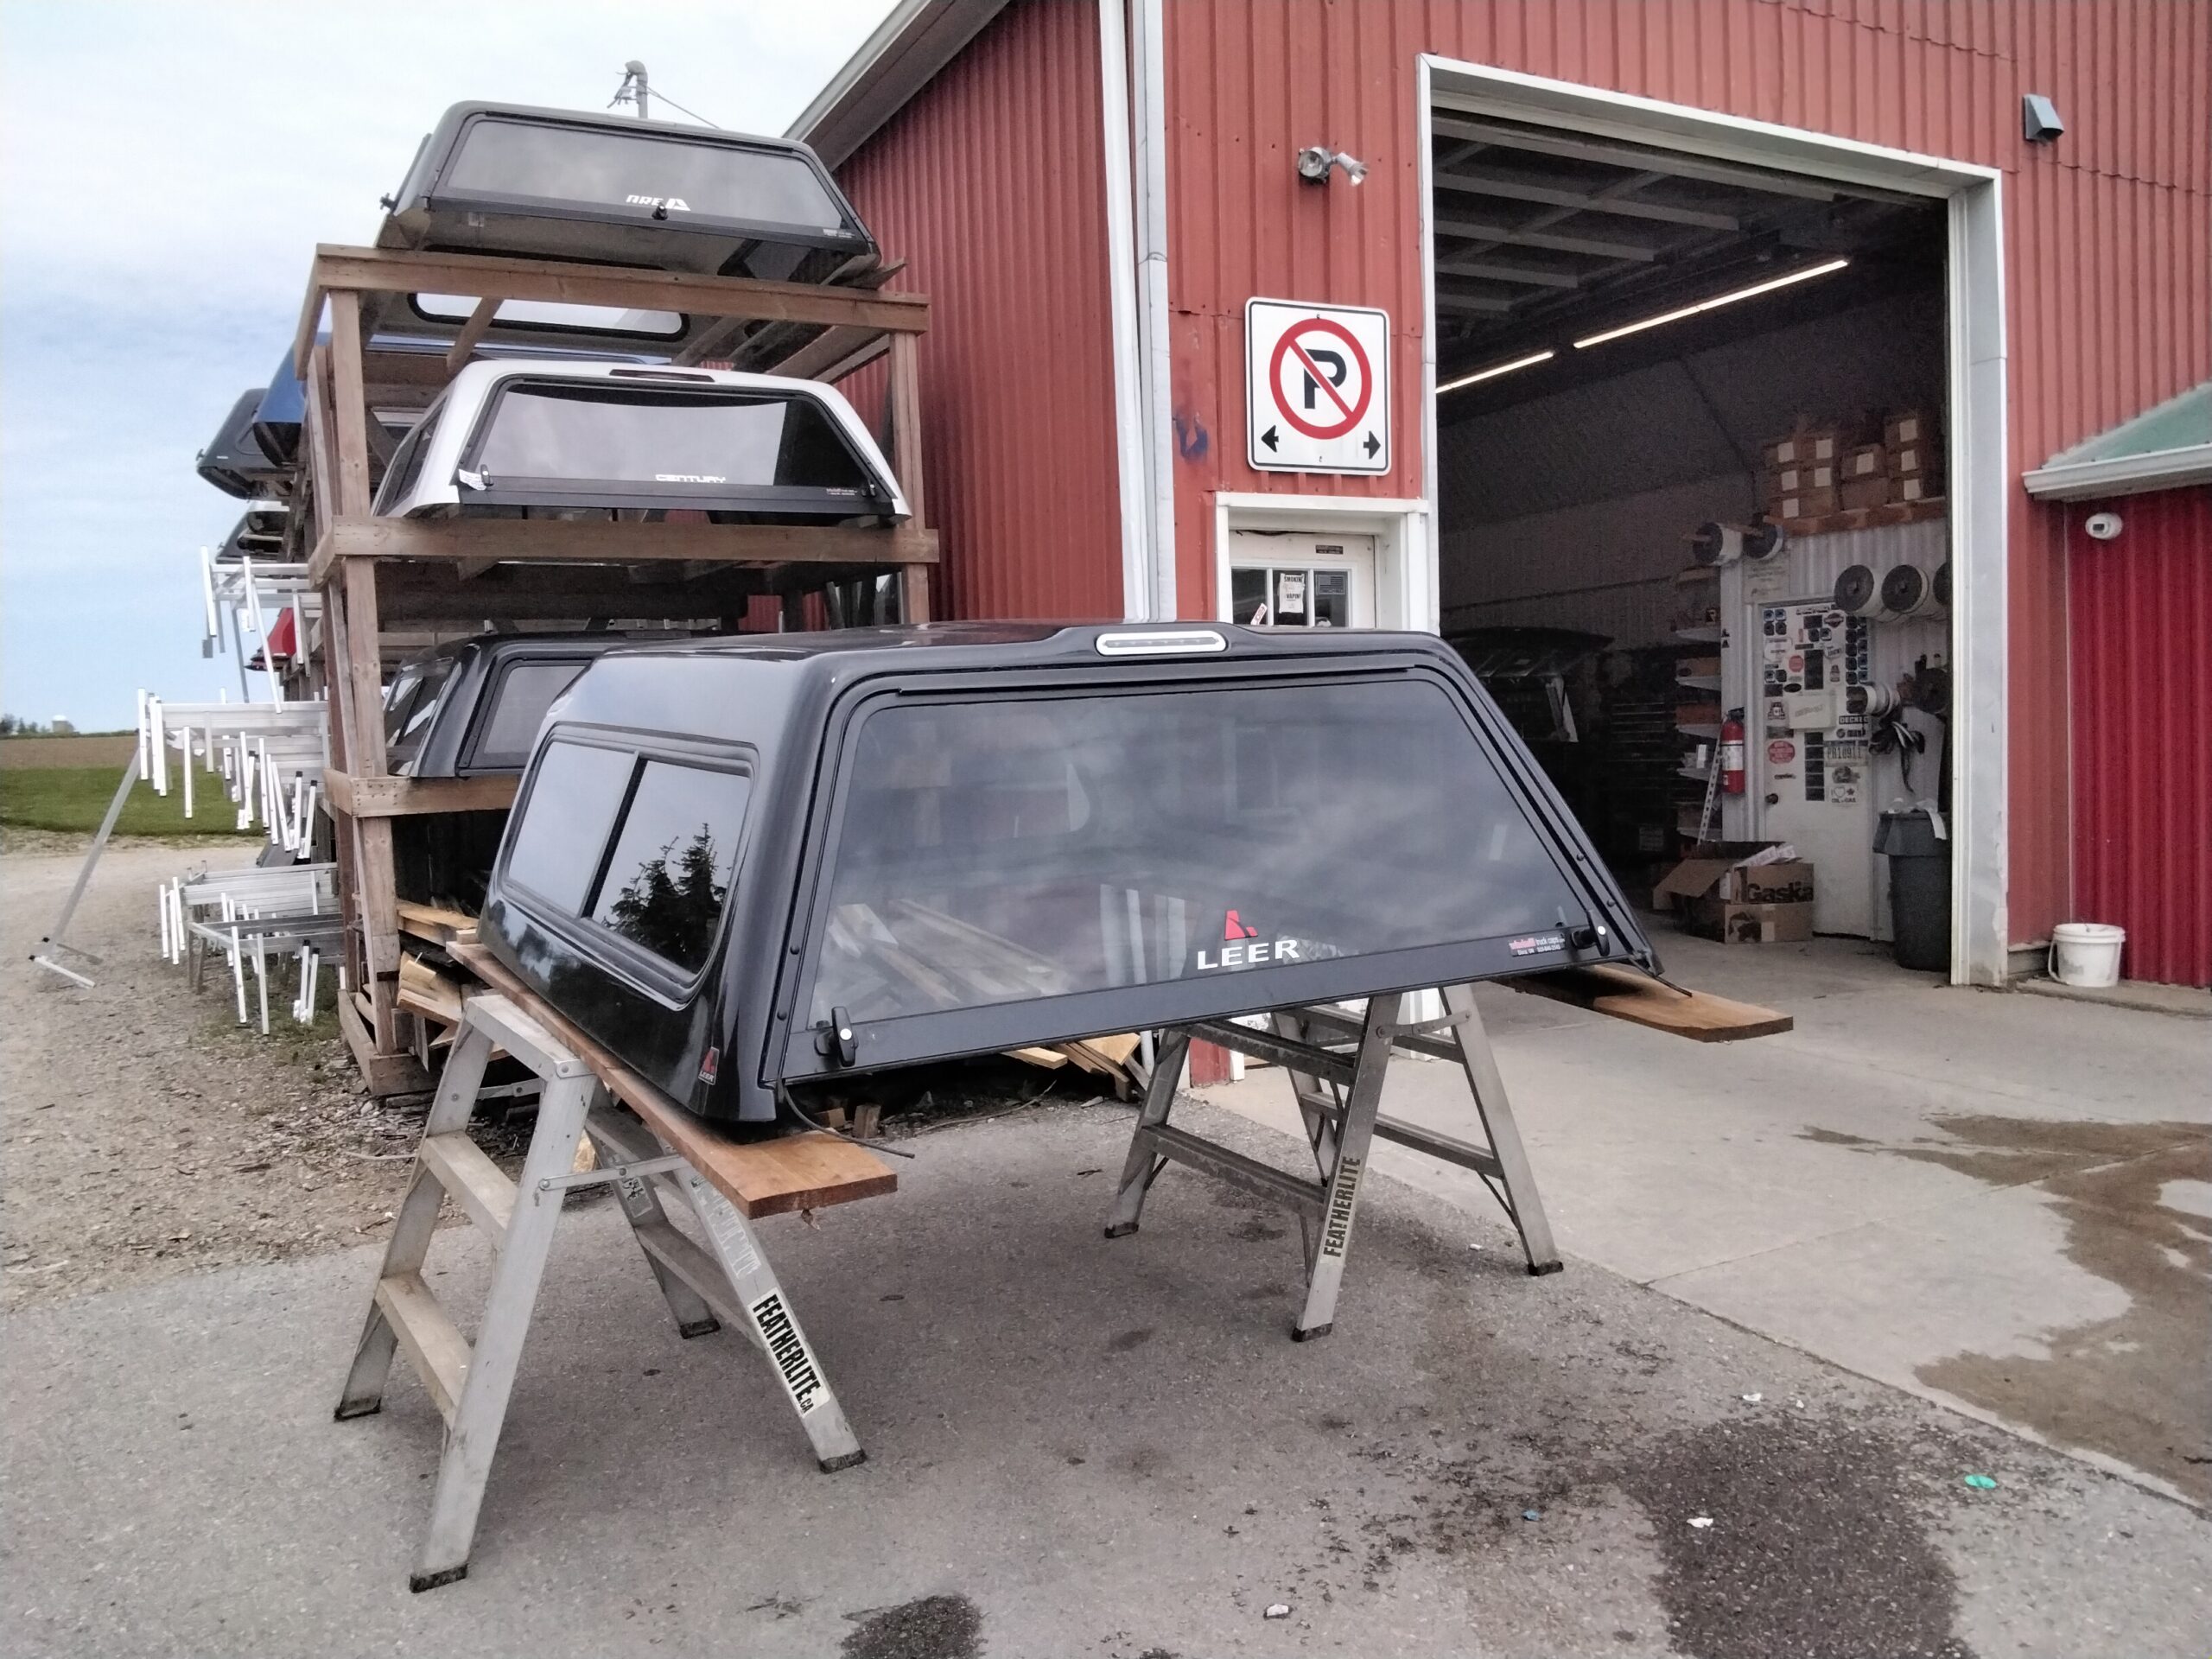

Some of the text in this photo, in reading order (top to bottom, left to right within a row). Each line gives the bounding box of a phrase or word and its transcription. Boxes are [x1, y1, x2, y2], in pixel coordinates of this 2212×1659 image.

[655, 474, 727, 484] CENTURY
[1198, 939, 1300, 969] LEER
[699, 1070, 715, 1082] LEER
[1323, 1156, 1361, 1258] FEATHERLITE
